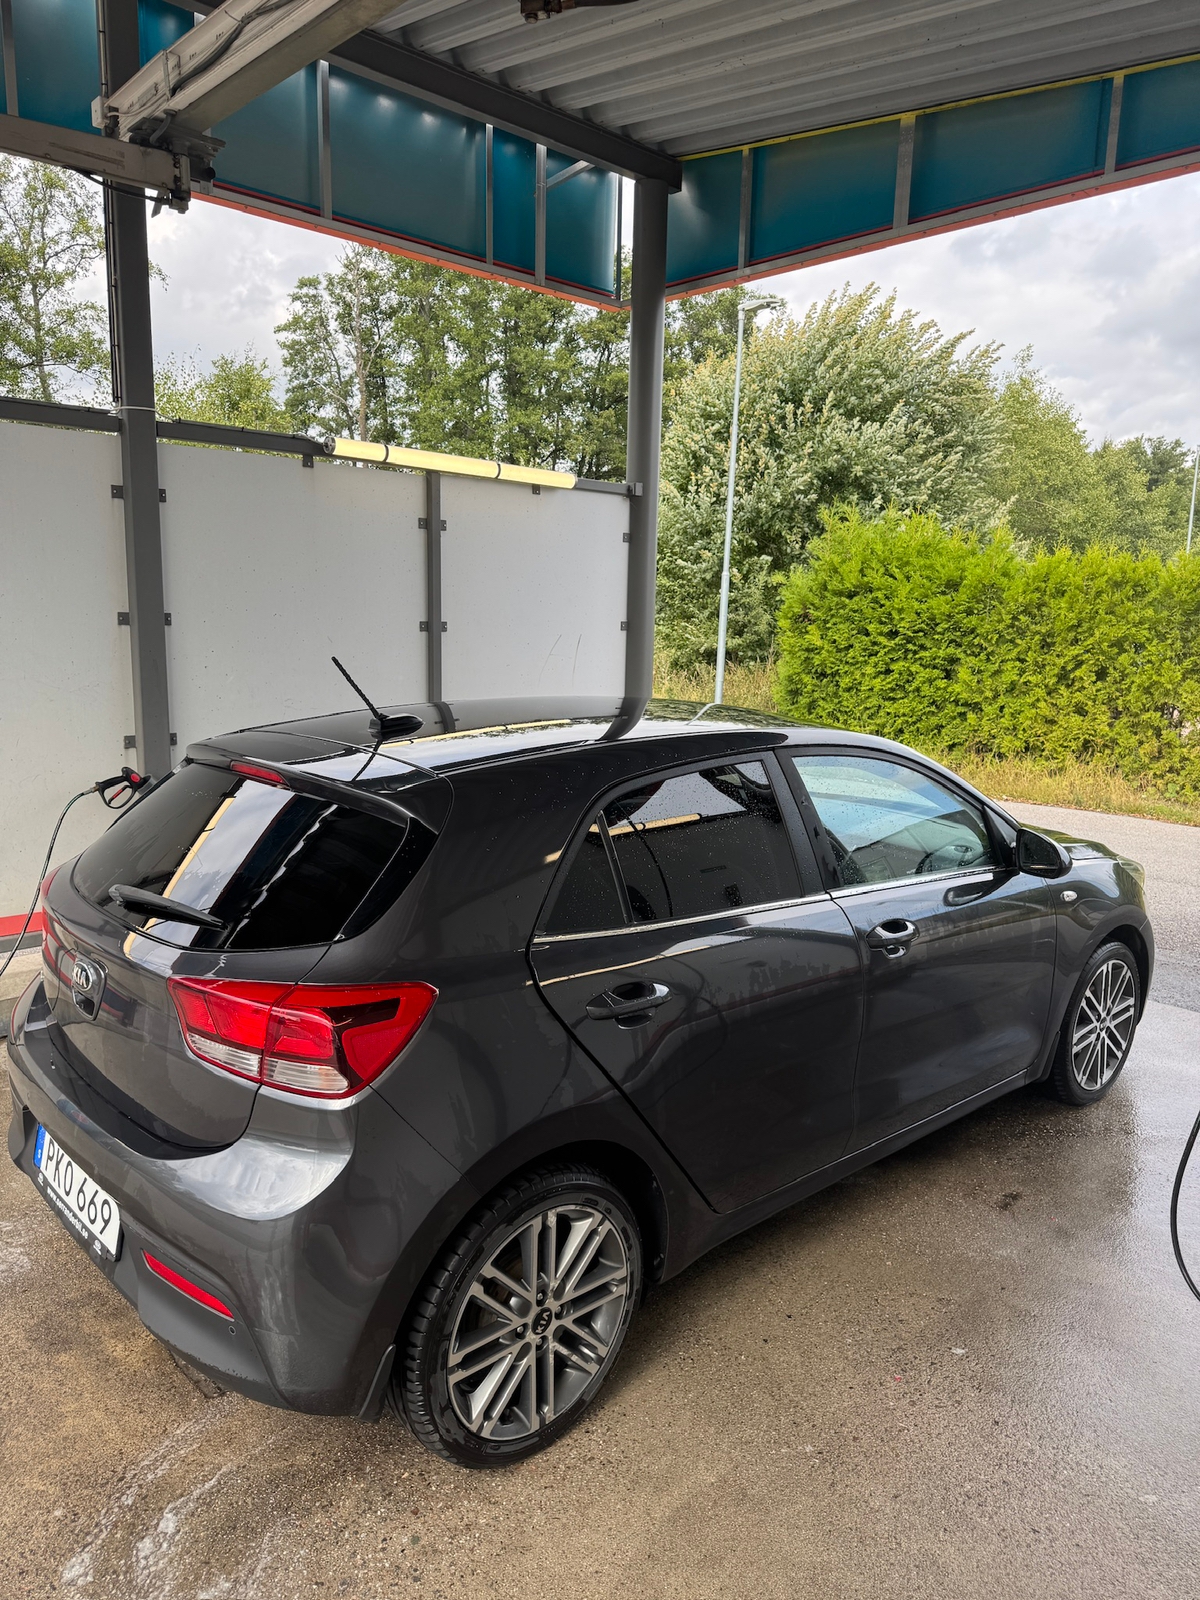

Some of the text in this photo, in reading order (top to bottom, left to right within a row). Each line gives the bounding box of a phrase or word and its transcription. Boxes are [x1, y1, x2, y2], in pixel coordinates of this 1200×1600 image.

[45, 1138, 112, 1235] PKO 669
[535, 1311, 551, 1333] KIA
